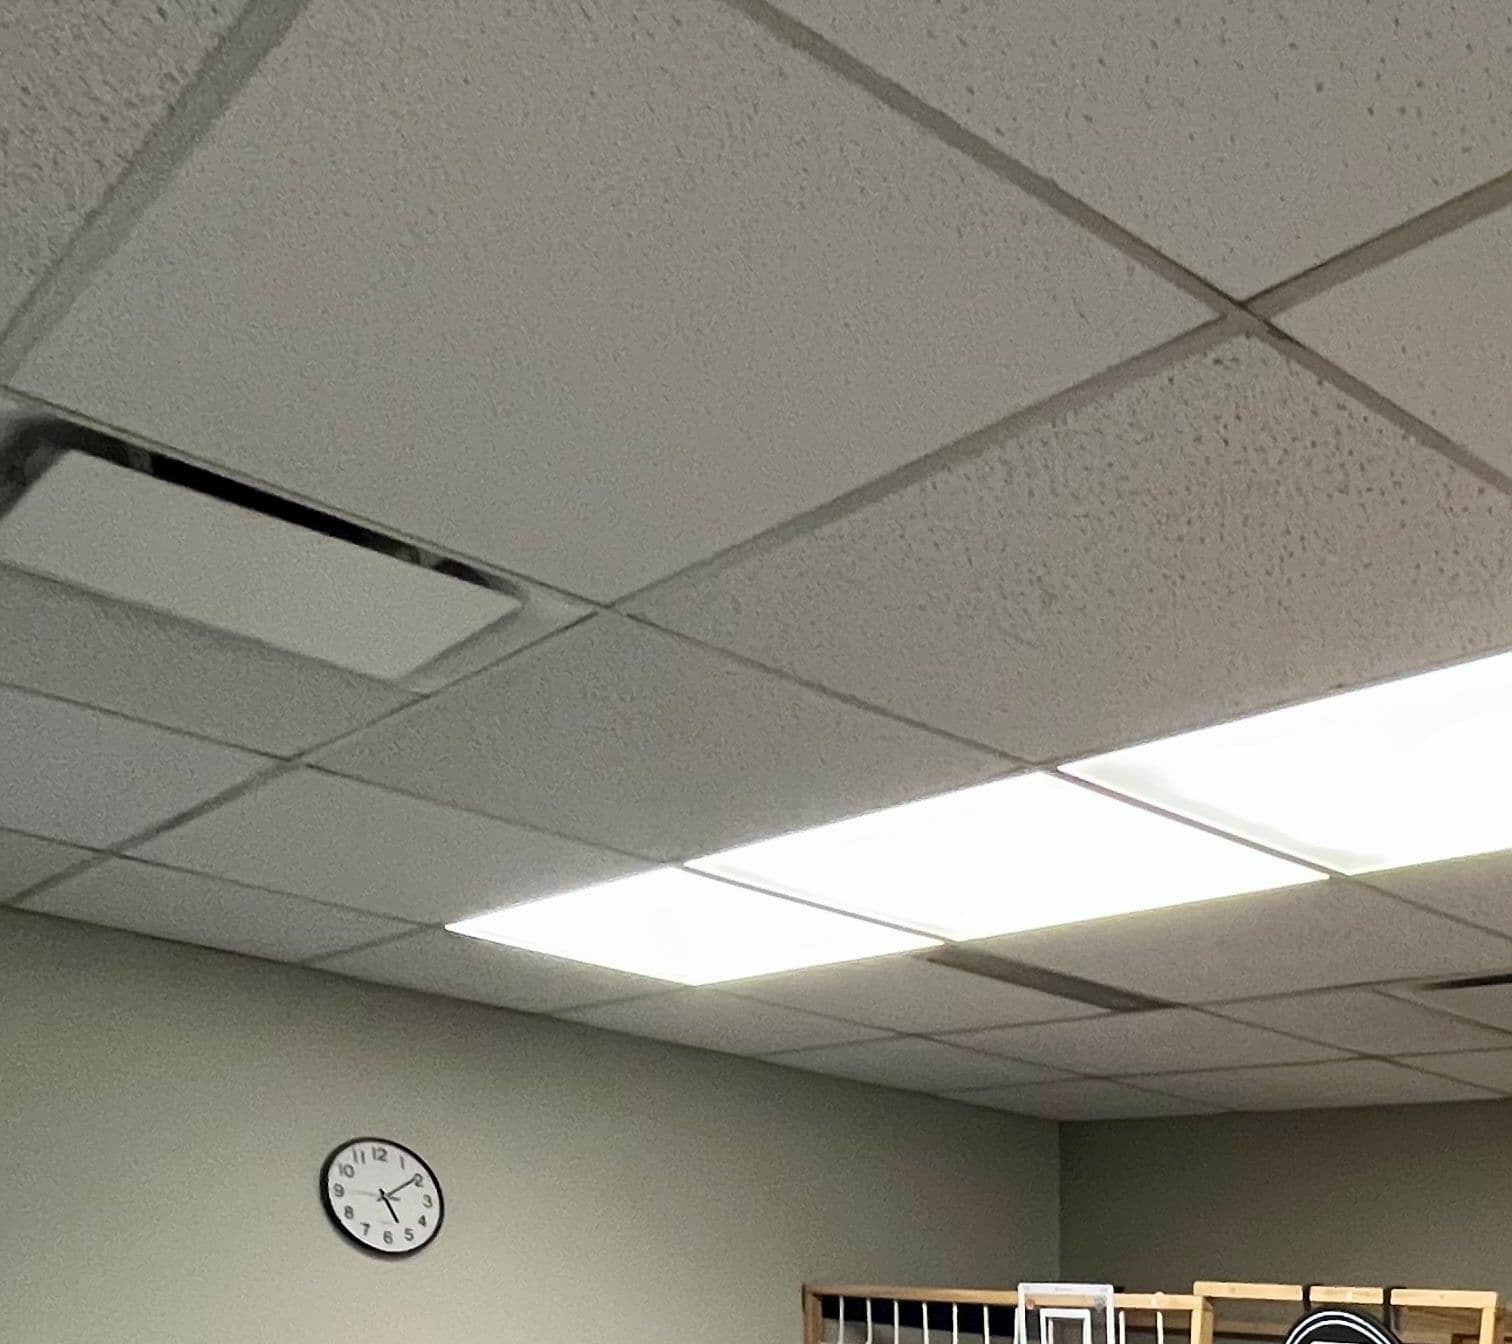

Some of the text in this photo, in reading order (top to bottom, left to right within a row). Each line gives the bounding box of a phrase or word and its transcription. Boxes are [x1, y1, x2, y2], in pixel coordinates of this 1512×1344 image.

[352, 1148, 366, 1164] 11
[371, 1146, 388, 1162] 12
[338, 1163, 355, 1178] 10
[413, 1173, 424, 1188] 2
[333, 1183, 345, 1198] 9
[423, 1194, 433, 1208] 3
[343, 1206, 354, 1219] 8
[360, 1223, 371, 1236] 7
[404, 1228, 414, 1241] 5
[383, 1231, 393, 1244] 6
